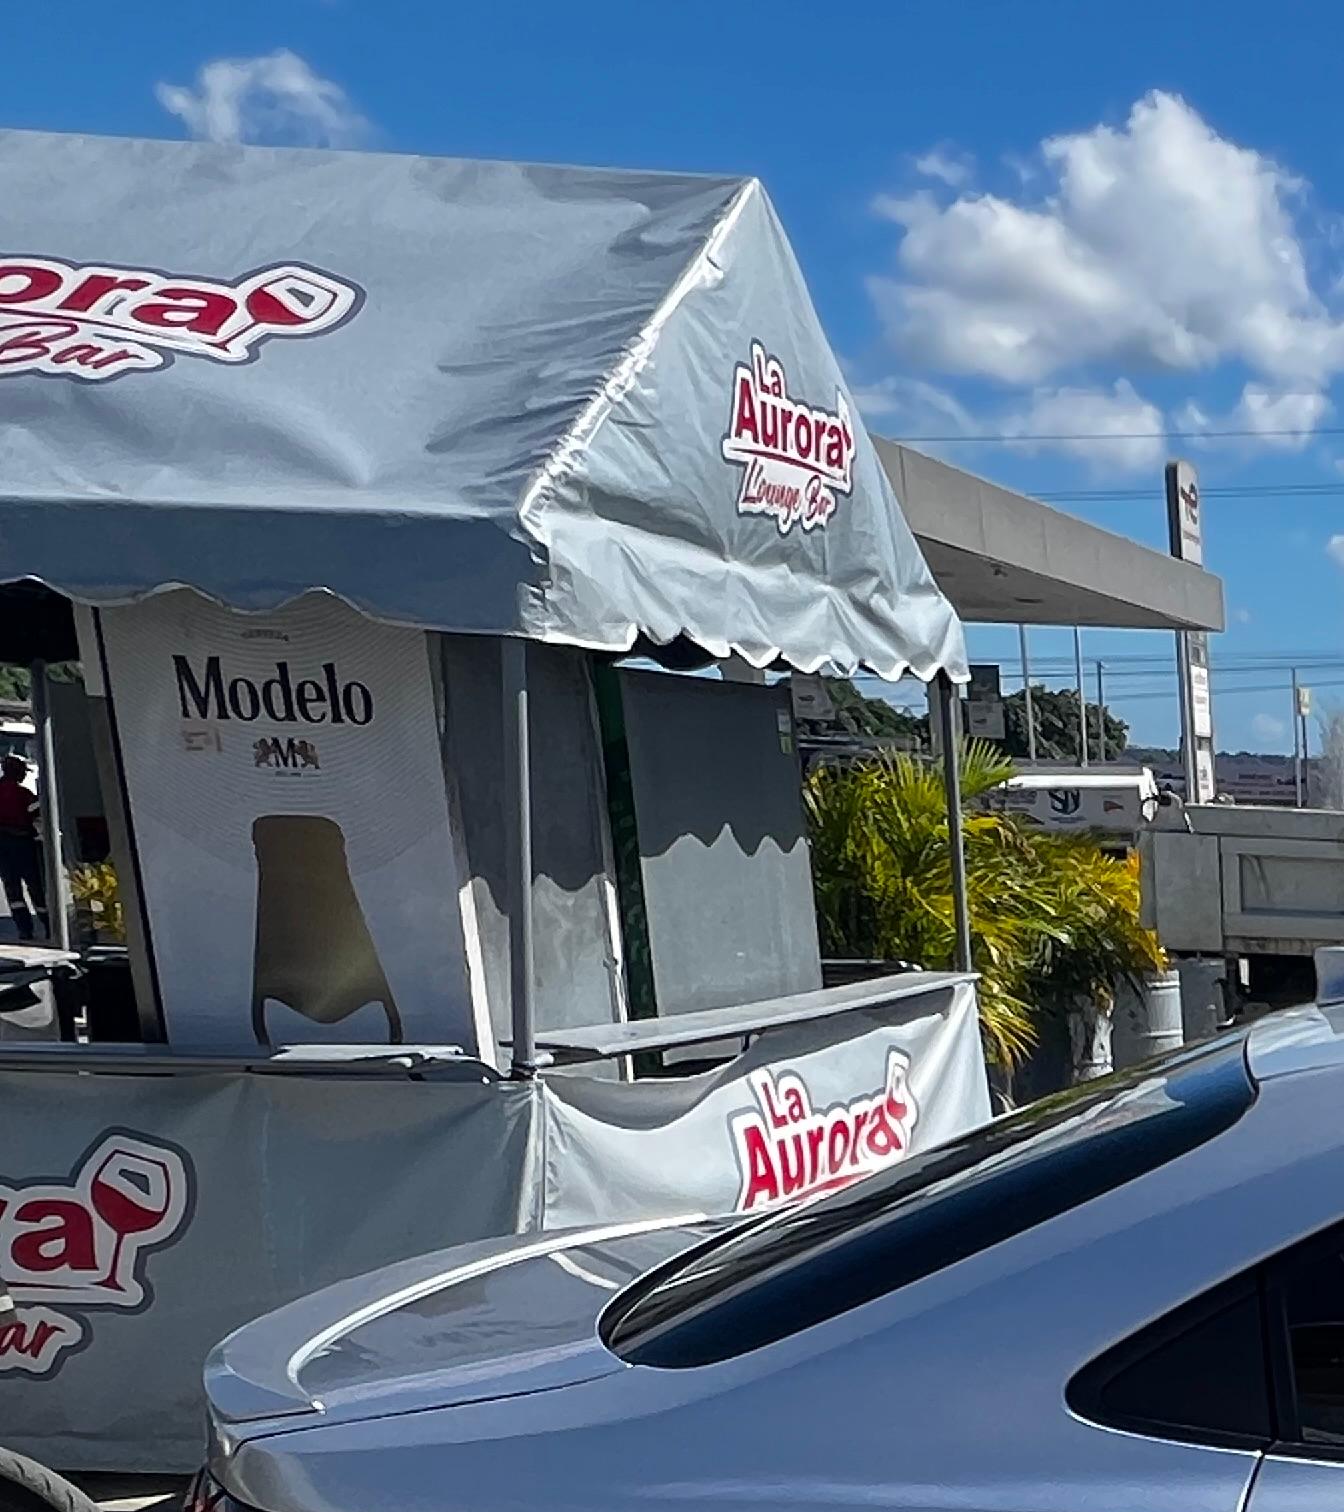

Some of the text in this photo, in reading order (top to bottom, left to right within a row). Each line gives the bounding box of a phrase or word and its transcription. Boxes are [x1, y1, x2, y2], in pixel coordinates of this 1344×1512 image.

[755, 353, 783, 399] La
[734, 377, 844, 470] Aurora
[804, 474, 832, 522] Bar
[171, 654, 374, 726] Modelo
[761, 1081, 806, 1130] La
[742, 1103, 903, 1210] Aurora
